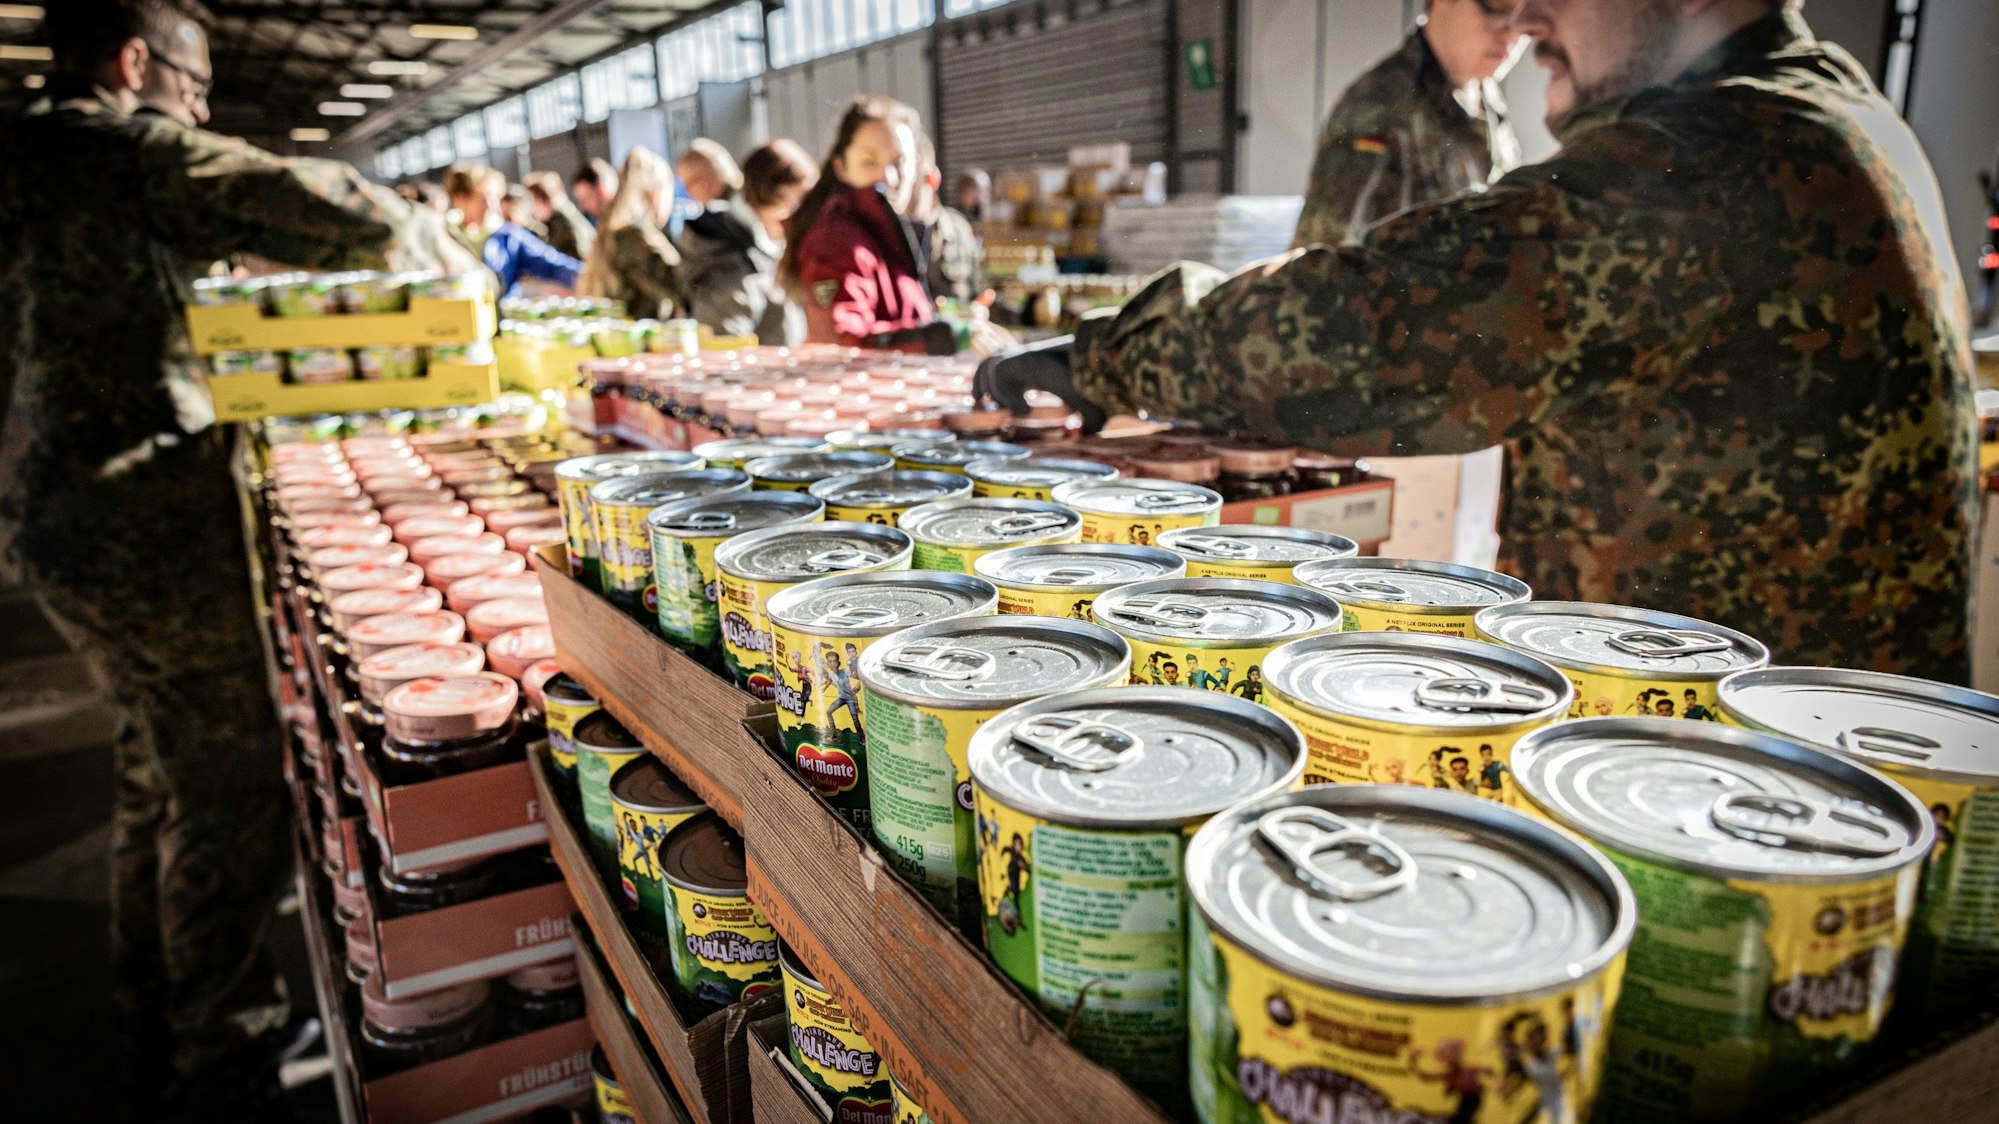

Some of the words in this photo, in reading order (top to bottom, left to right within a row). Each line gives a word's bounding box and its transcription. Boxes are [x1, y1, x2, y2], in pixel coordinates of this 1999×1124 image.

[799, 755, 815, 772] Del
[815, 758, 854, 779] Monte
[811, 772, 838, 788] Quality
[896, 835, 924, 861] 415g
[898, 855, 926, 881] 250g
[686, 935, 777, 963] CHALLENGE
[707, 931, 748, 943] DINOSAUR
[757, 883, 780, 925] JUICE
[786, 921, 800, 950] AU
[801, 940, 820, 975] JUS
[828, 974, 845, 1000] OP
[848, 996, 870, 1032] SAP
[880, 1035, 896, 1070] IN
[899, 1058, 929, 1108] SAFT
[814, 1018, 824, 1027] NOW
[824, 1022, 853, 1034] STREAMING
[804, 1028, 844, 1049] DINOSAUR
[791, 1027, 876, 1076] CHALLENGE
[842, 1107, 862, 1122] Del
[862, 1109, 891, 1124] Mon
